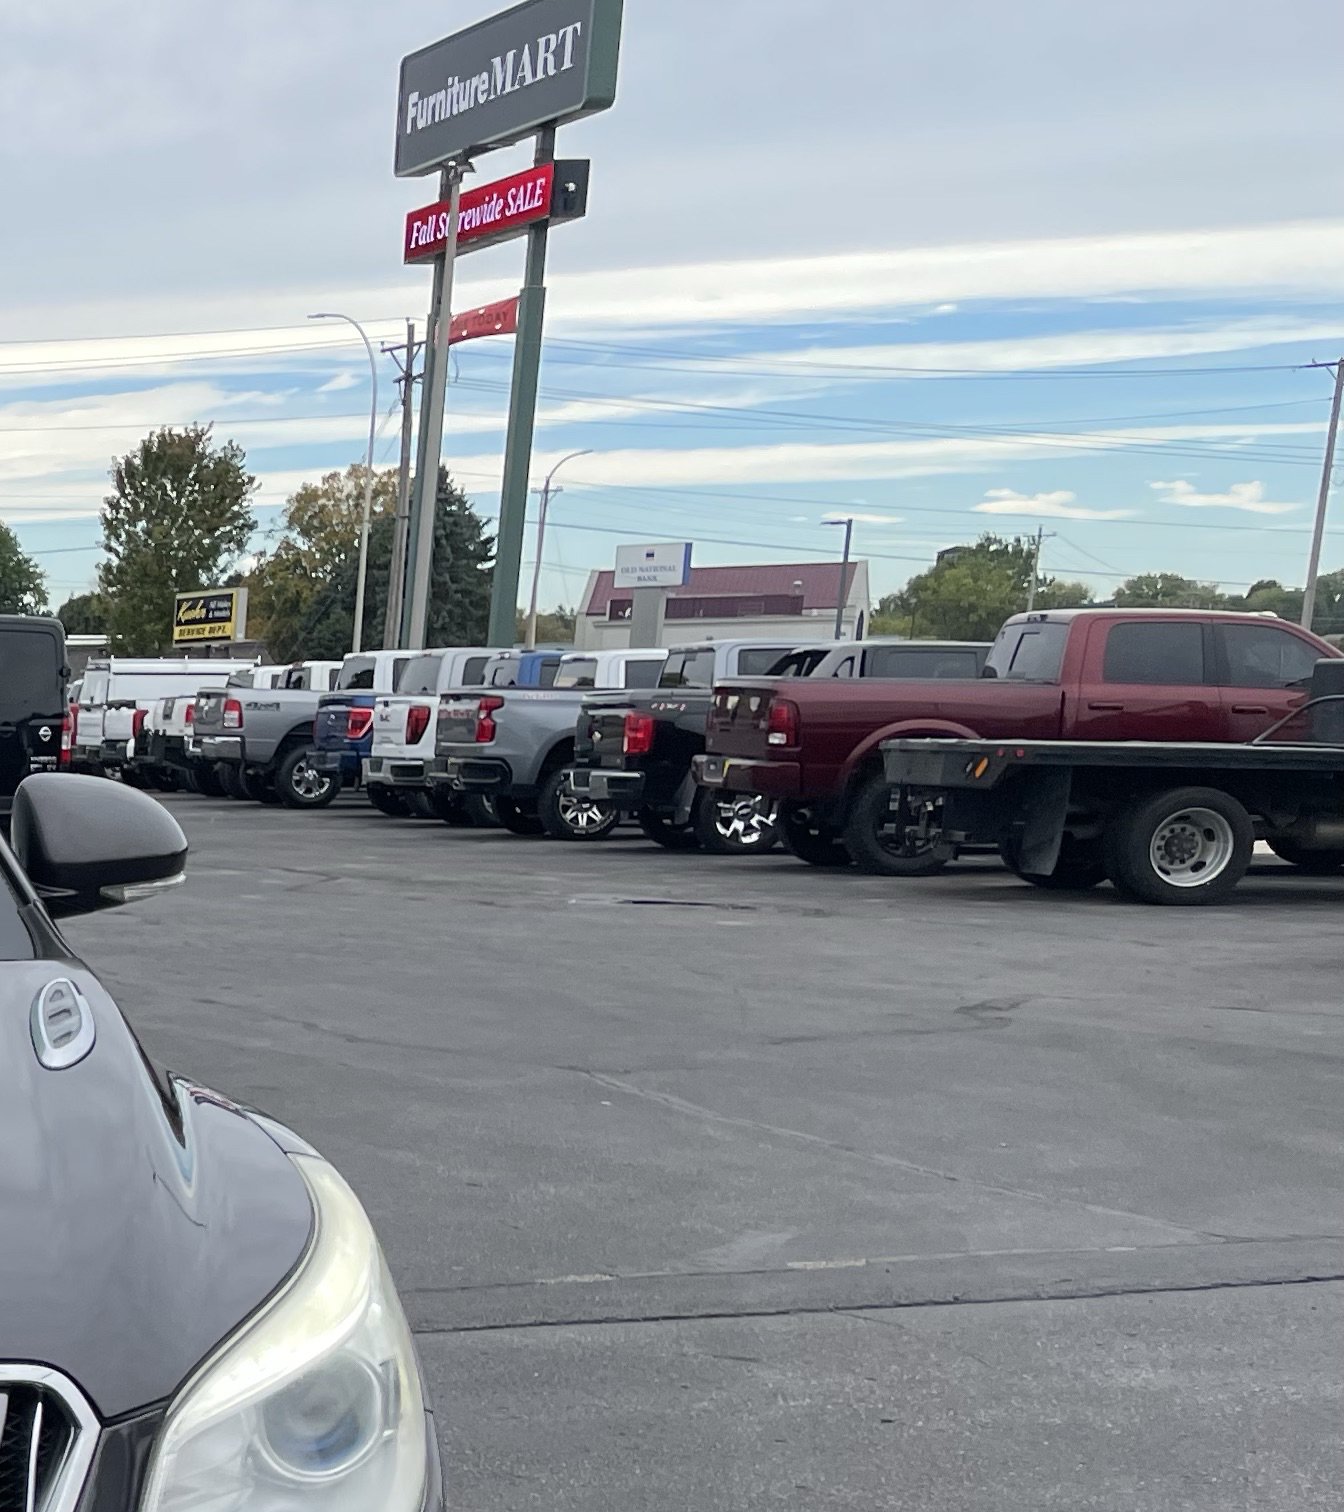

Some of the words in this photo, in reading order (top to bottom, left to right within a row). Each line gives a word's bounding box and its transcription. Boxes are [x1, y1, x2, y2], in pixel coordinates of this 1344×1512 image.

[410, 212, 436, 249] Fall
[436, 192, 504, 240] Strewide
[505, 176, 546, 217] SALE
[621, 565, 638, 574] OLD
[638, 564, 677, 573] NATIONAL
